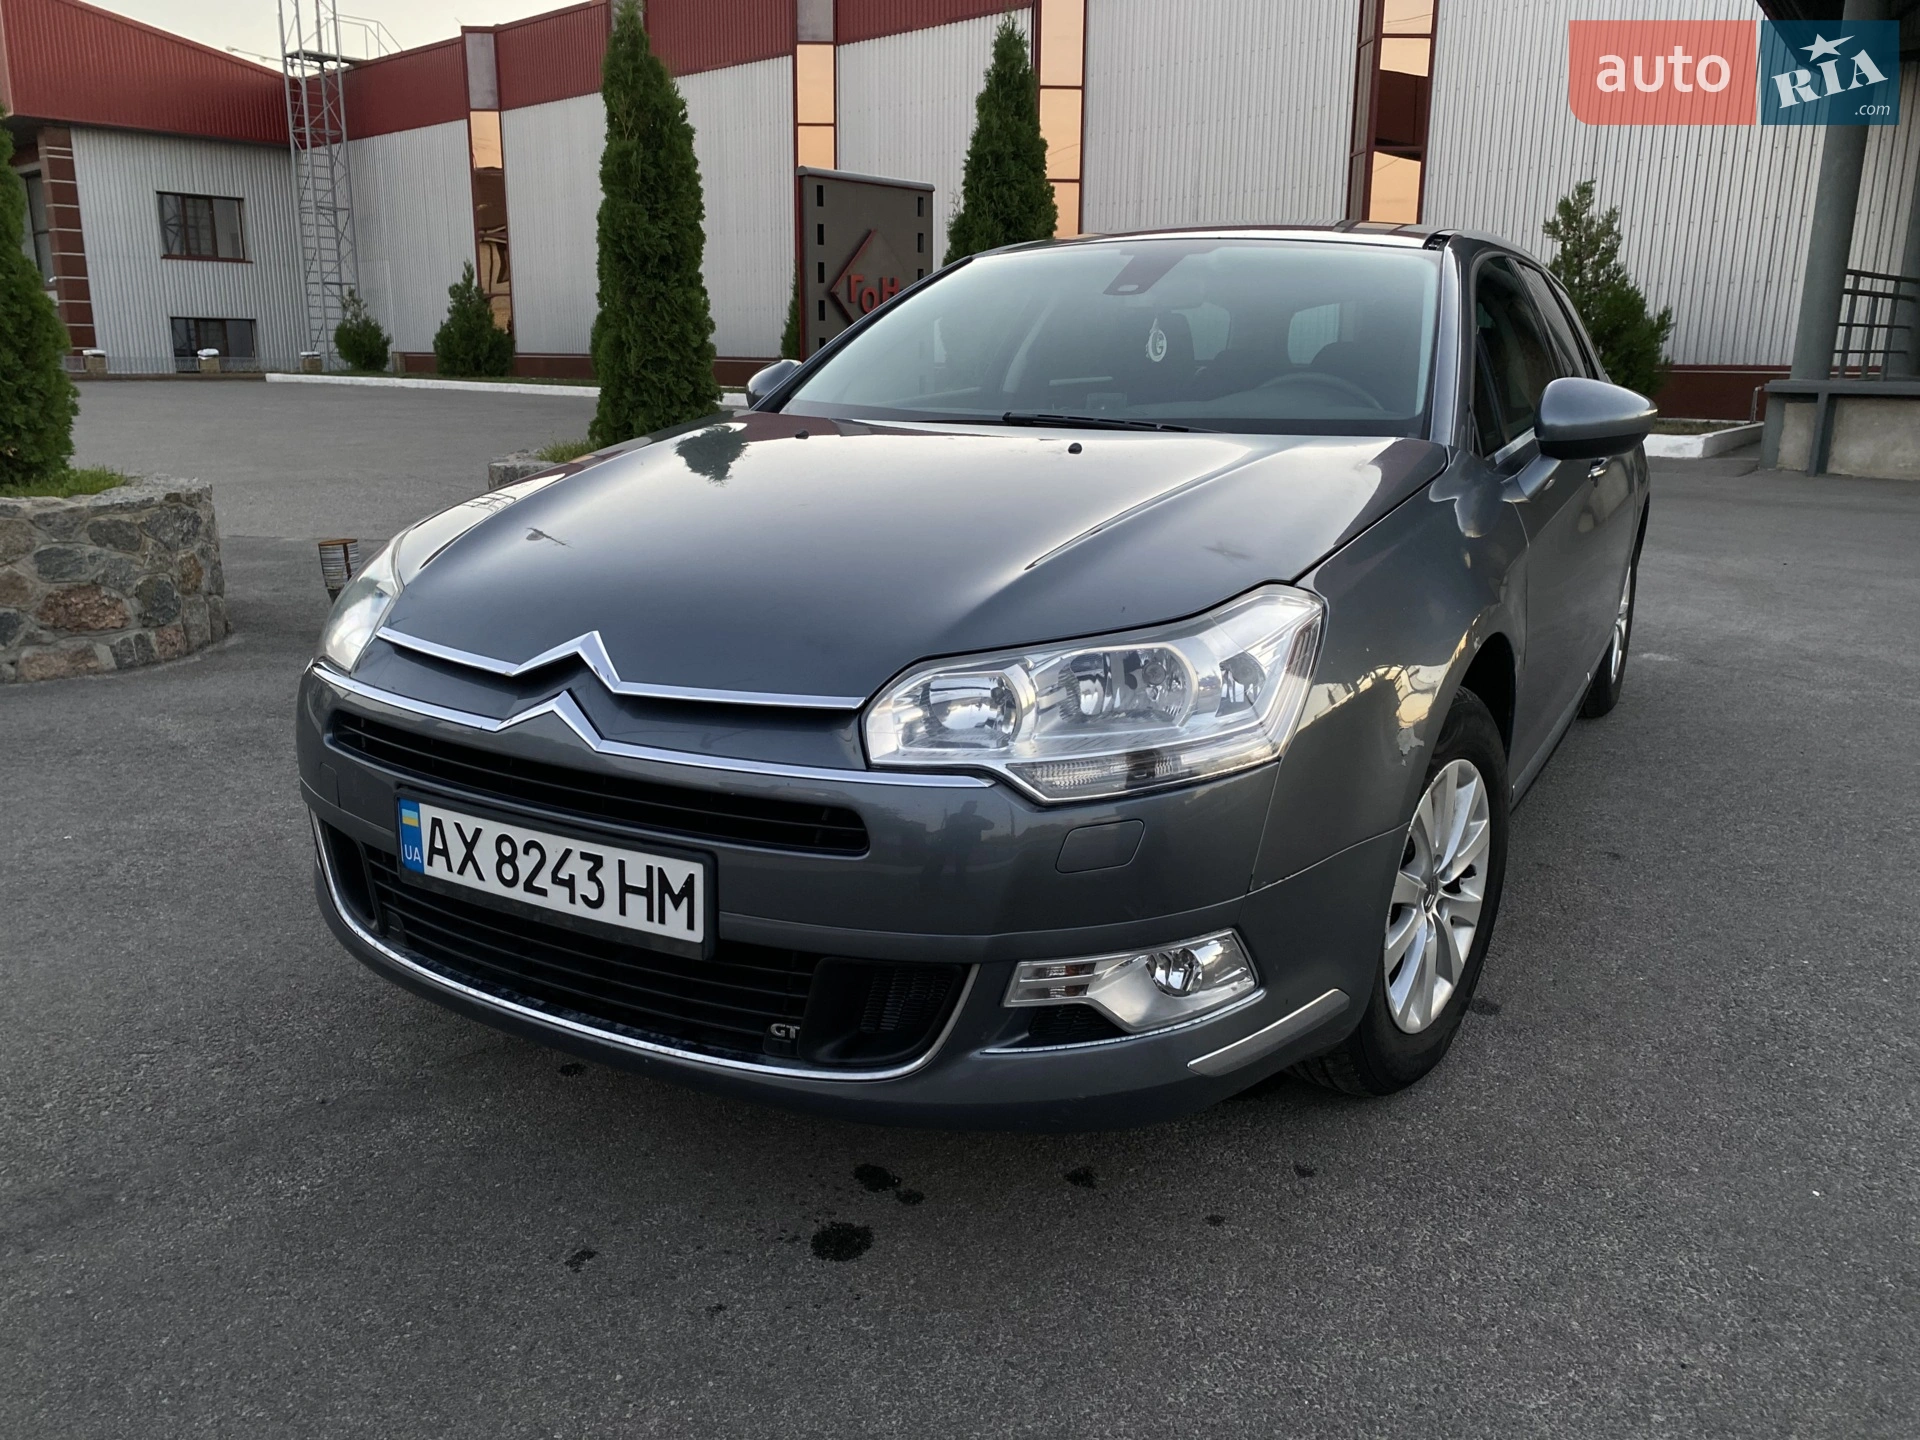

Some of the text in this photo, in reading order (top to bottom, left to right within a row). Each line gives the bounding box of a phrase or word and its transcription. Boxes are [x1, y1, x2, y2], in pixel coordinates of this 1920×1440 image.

[403, 843, 422, 864] UA
[427, 816, 696, 932] AX 8243 HM
[770, 1022, 801, 1040] GT
